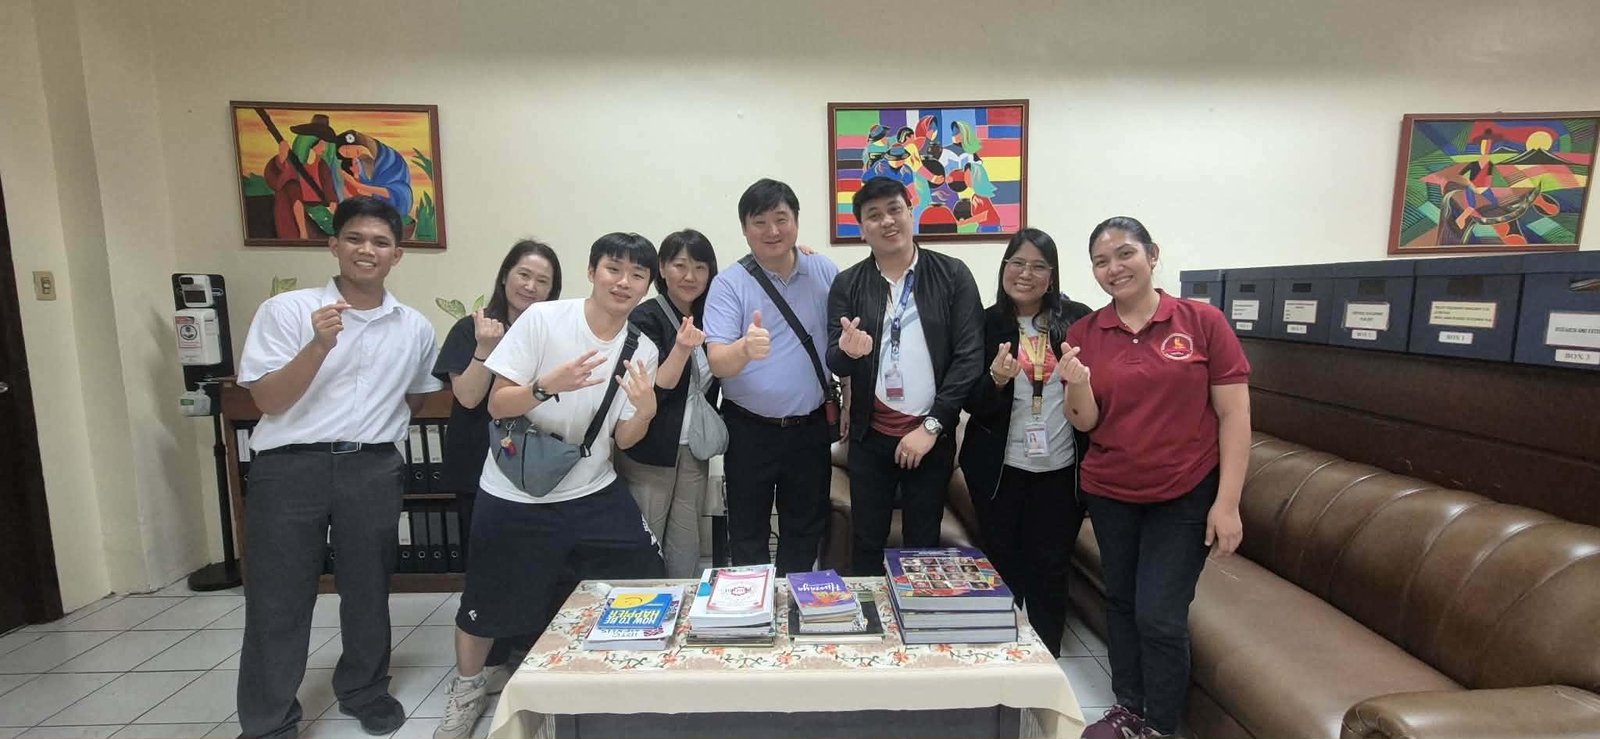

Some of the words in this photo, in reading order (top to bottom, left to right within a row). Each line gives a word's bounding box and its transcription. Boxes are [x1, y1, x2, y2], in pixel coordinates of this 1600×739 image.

[608, 609, 661, 619] HAPPIER
[618, 617, 631, 625] TO
[632, 617, 656, 625] HOW
